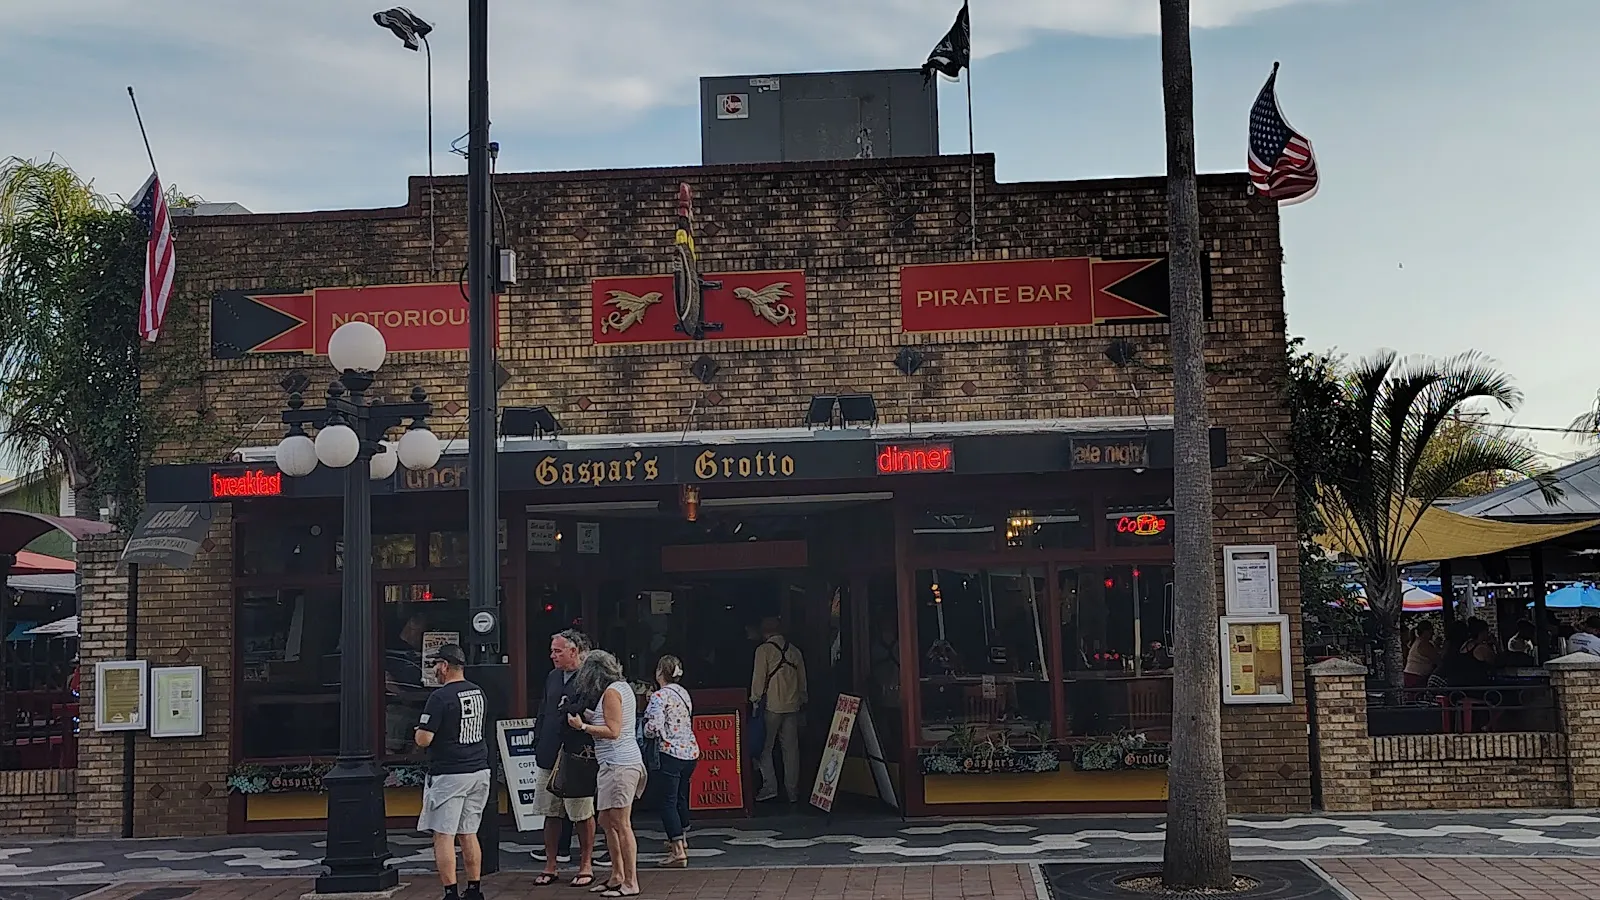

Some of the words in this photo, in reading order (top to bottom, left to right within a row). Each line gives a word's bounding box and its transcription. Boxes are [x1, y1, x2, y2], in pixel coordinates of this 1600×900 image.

[916, 285, 1011, 308] PIRATE
[1017, 284, 1073, 303] BAR
[331, 308, 470, 330] NOTORIOU
[877, 446, 952, 473] dinner
[535, 451, 660, 486] Gaspar's
[694, 450, 794, 480] Grotto
[211, 469, 282, 498] breakfast
[698, 719, 733, 731] FOOD
[699, 749, 735, 761] DRINK
[1124, 752, 1166, 766] Grotto
[271, 776, 321, 787] Gaspar's
[703, 780, 730, 792] LIVE
[698, 792, 735, 805] MUSIC
